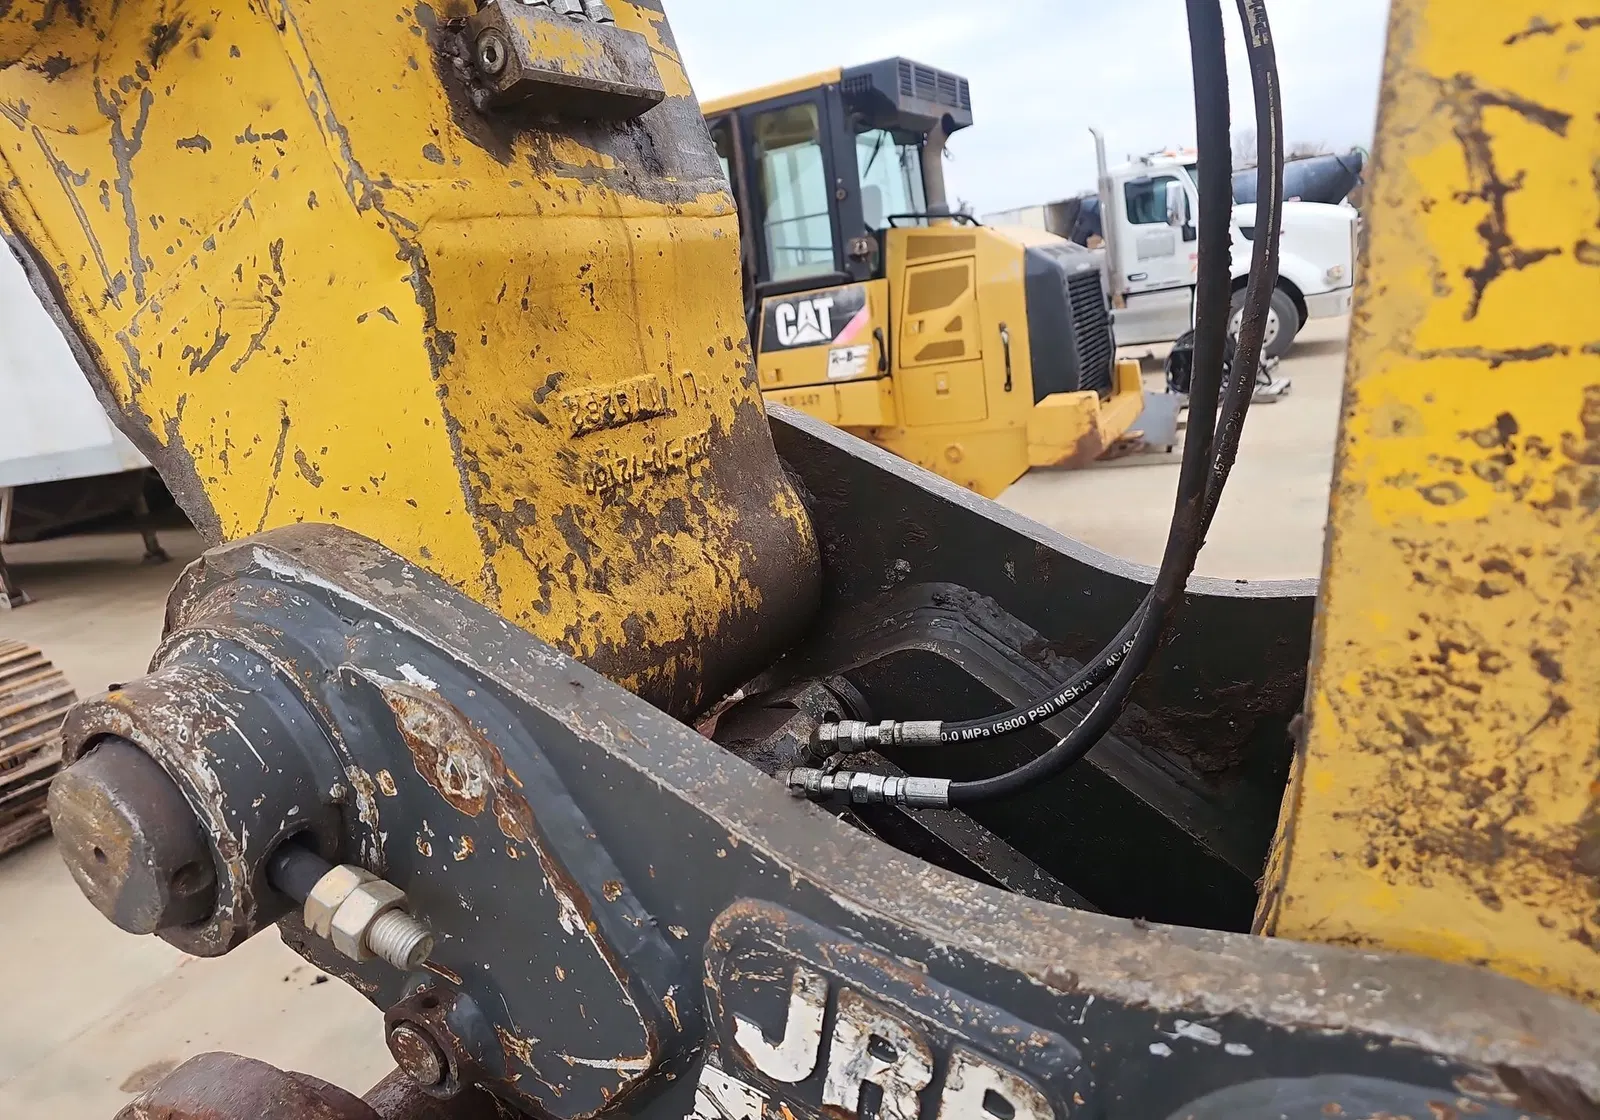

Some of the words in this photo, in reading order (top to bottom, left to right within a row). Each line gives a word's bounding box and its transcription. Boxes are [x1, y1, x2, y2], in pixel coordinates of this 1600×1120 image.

[775, 298, 834, 346] CAT
[962, 727, 990, 740] MPa
[992, 715, 1027, 735] (5800
[1027, 701, 1055, 722] PSI)
